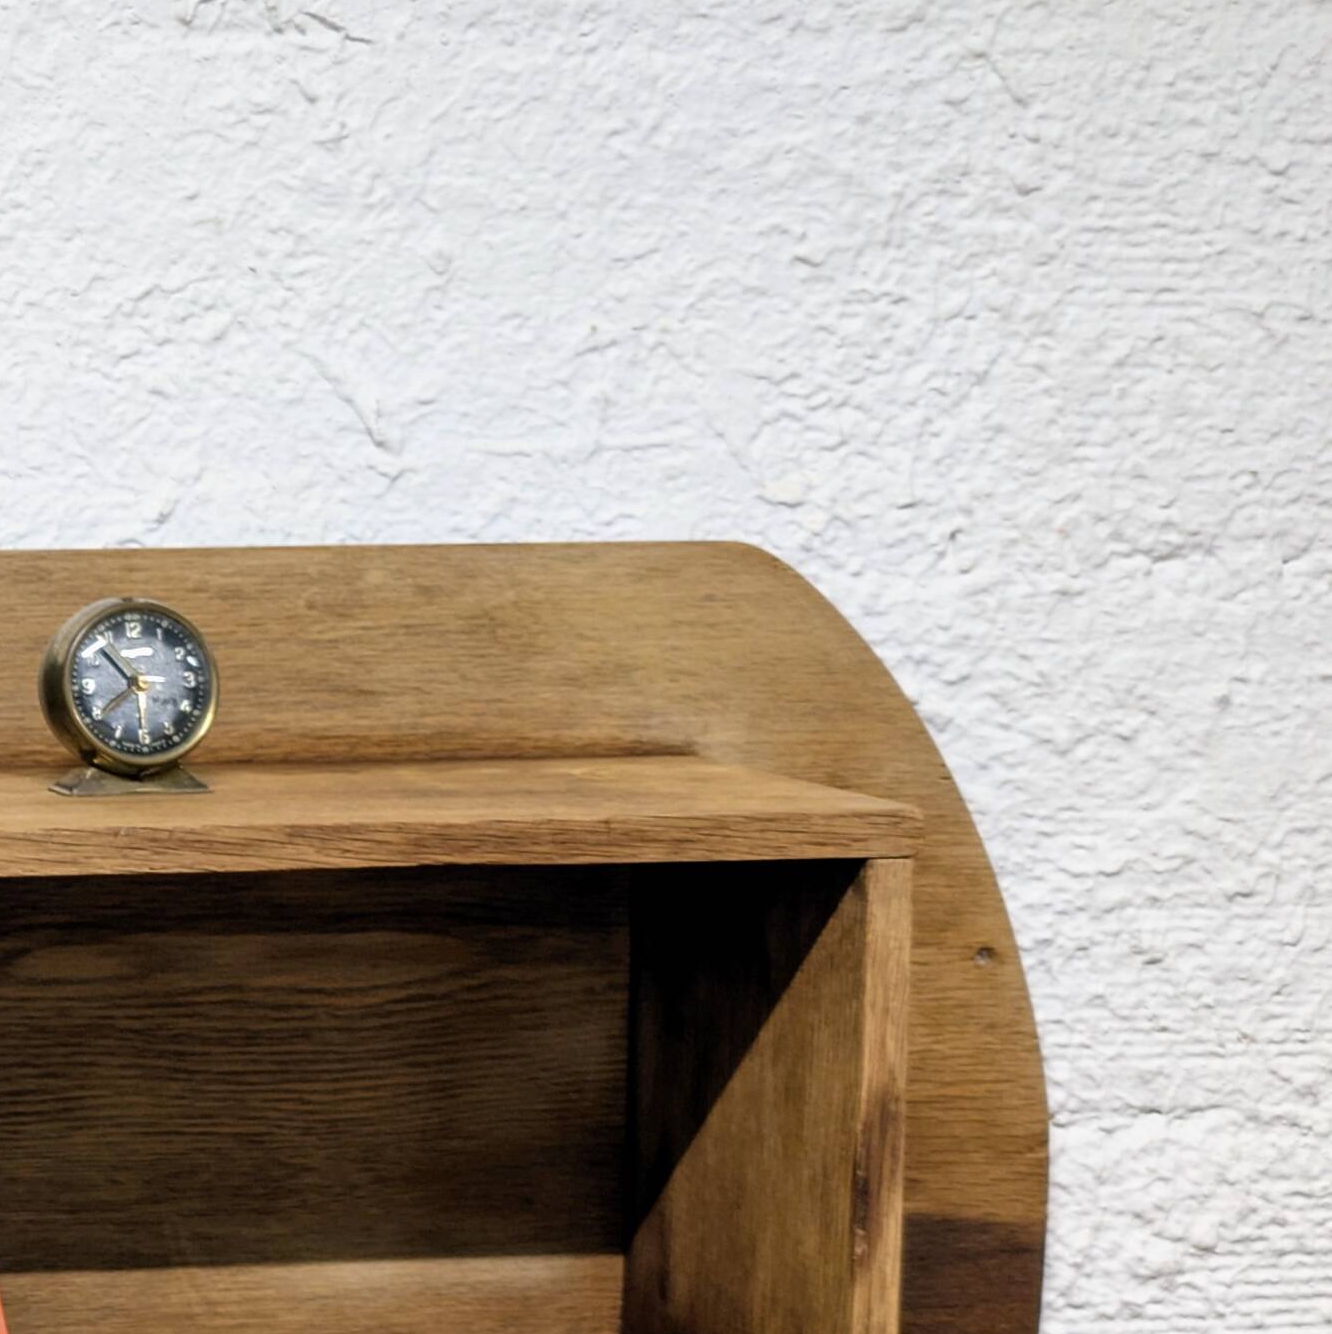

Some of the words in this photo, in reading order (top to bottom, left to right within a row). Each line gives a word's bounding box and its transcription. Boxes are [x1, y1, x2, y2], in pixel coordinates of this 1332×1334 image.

[125, 621, 142, 639] 12
[174, 647, 185, 661] 2
[82, 678, 96, 695] 9
[183, 672, 196, 688] 3
[138, 728, 151, 745] 6
